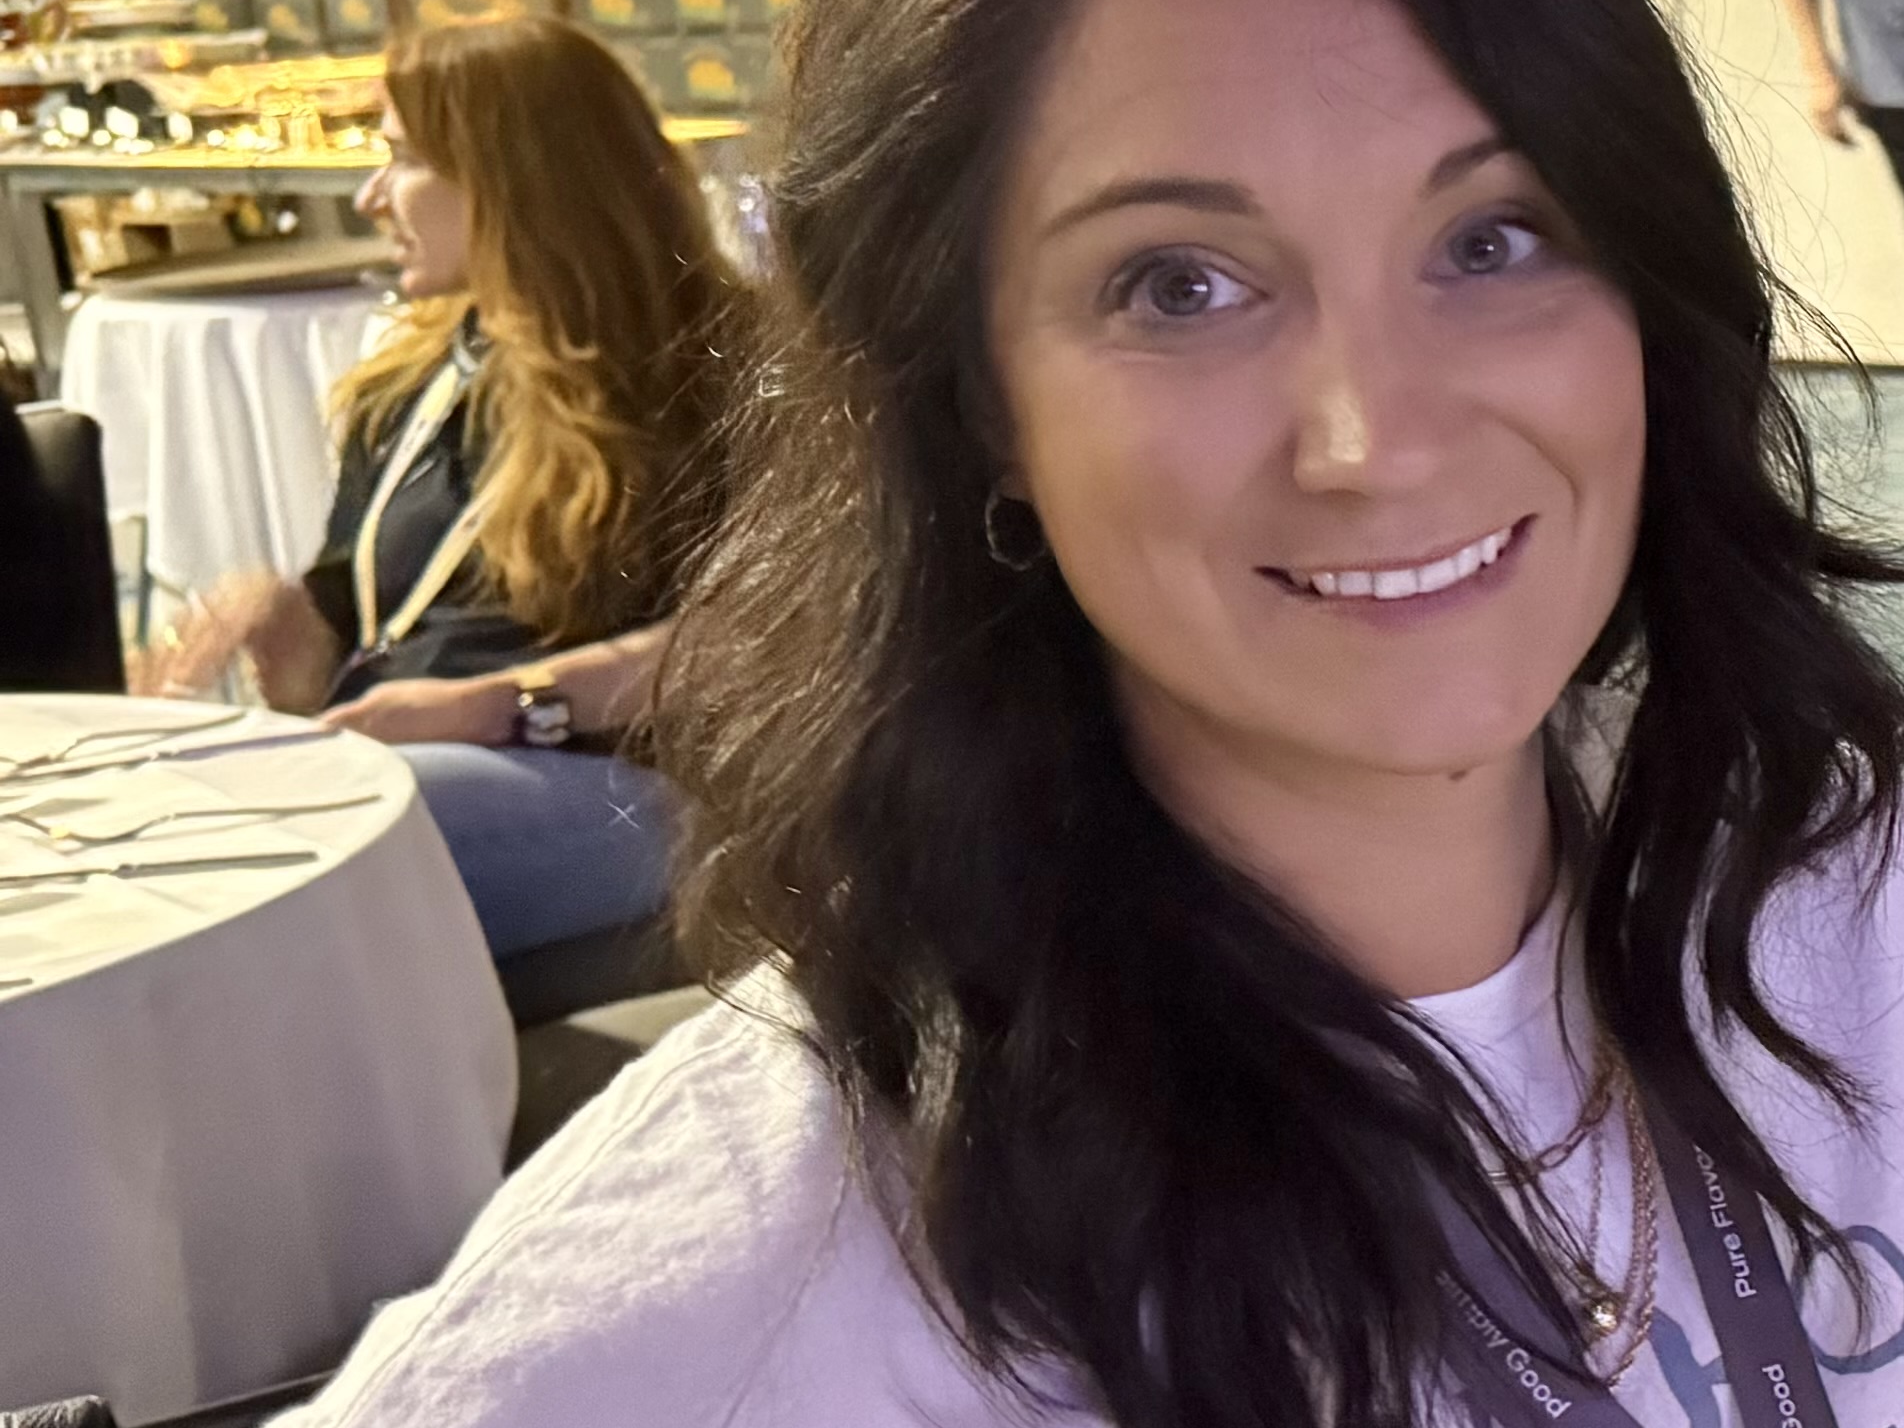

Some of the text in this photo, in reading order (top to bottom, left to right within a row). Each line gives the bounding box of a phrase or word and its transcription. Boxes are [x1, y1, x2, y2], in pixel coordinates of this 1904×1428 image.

[1692, 1139, 1758, 1299] Pure Flavo
[1506, 1347, 1573, 1419] Good
